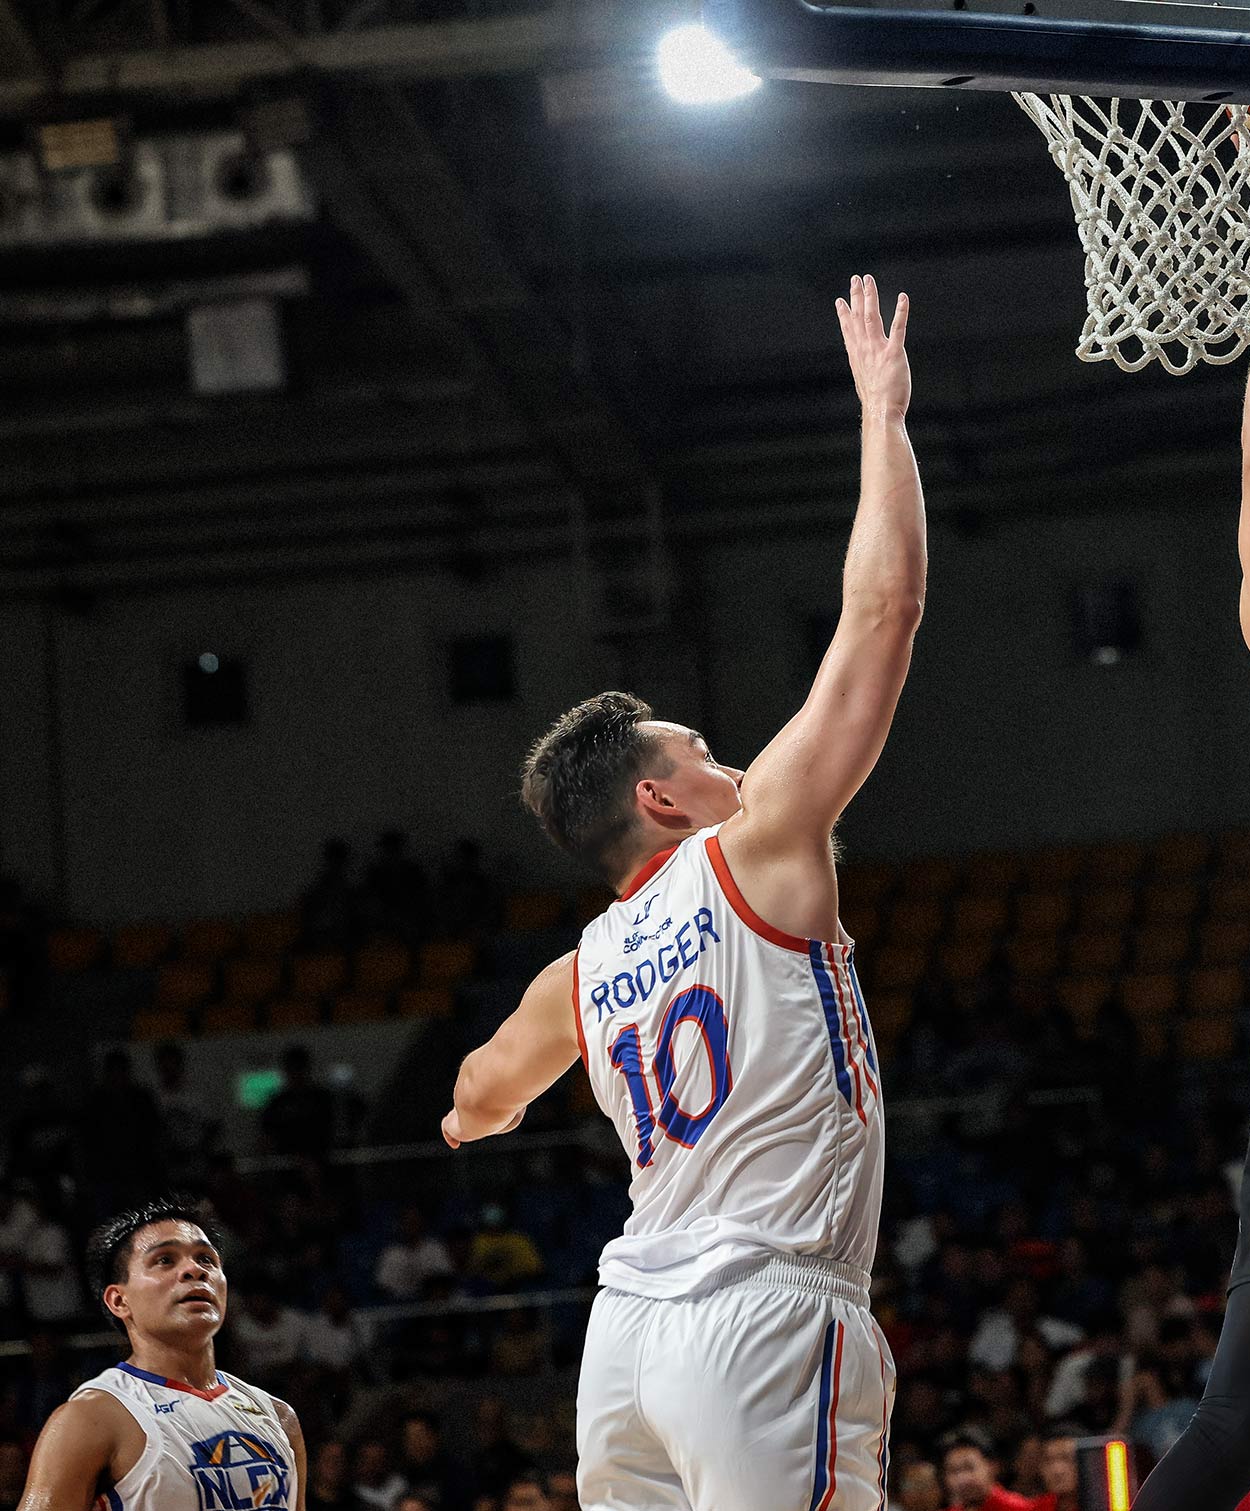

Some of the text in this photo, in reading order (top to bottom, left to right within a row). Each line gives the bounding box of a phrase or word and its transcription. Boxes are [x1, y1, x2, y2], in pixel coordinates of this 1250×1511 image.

[590, 906, 721, 1023] RODGER
[607, 983, 734, 1169] 10
[198, 1464, 288, 1511] NLEX
